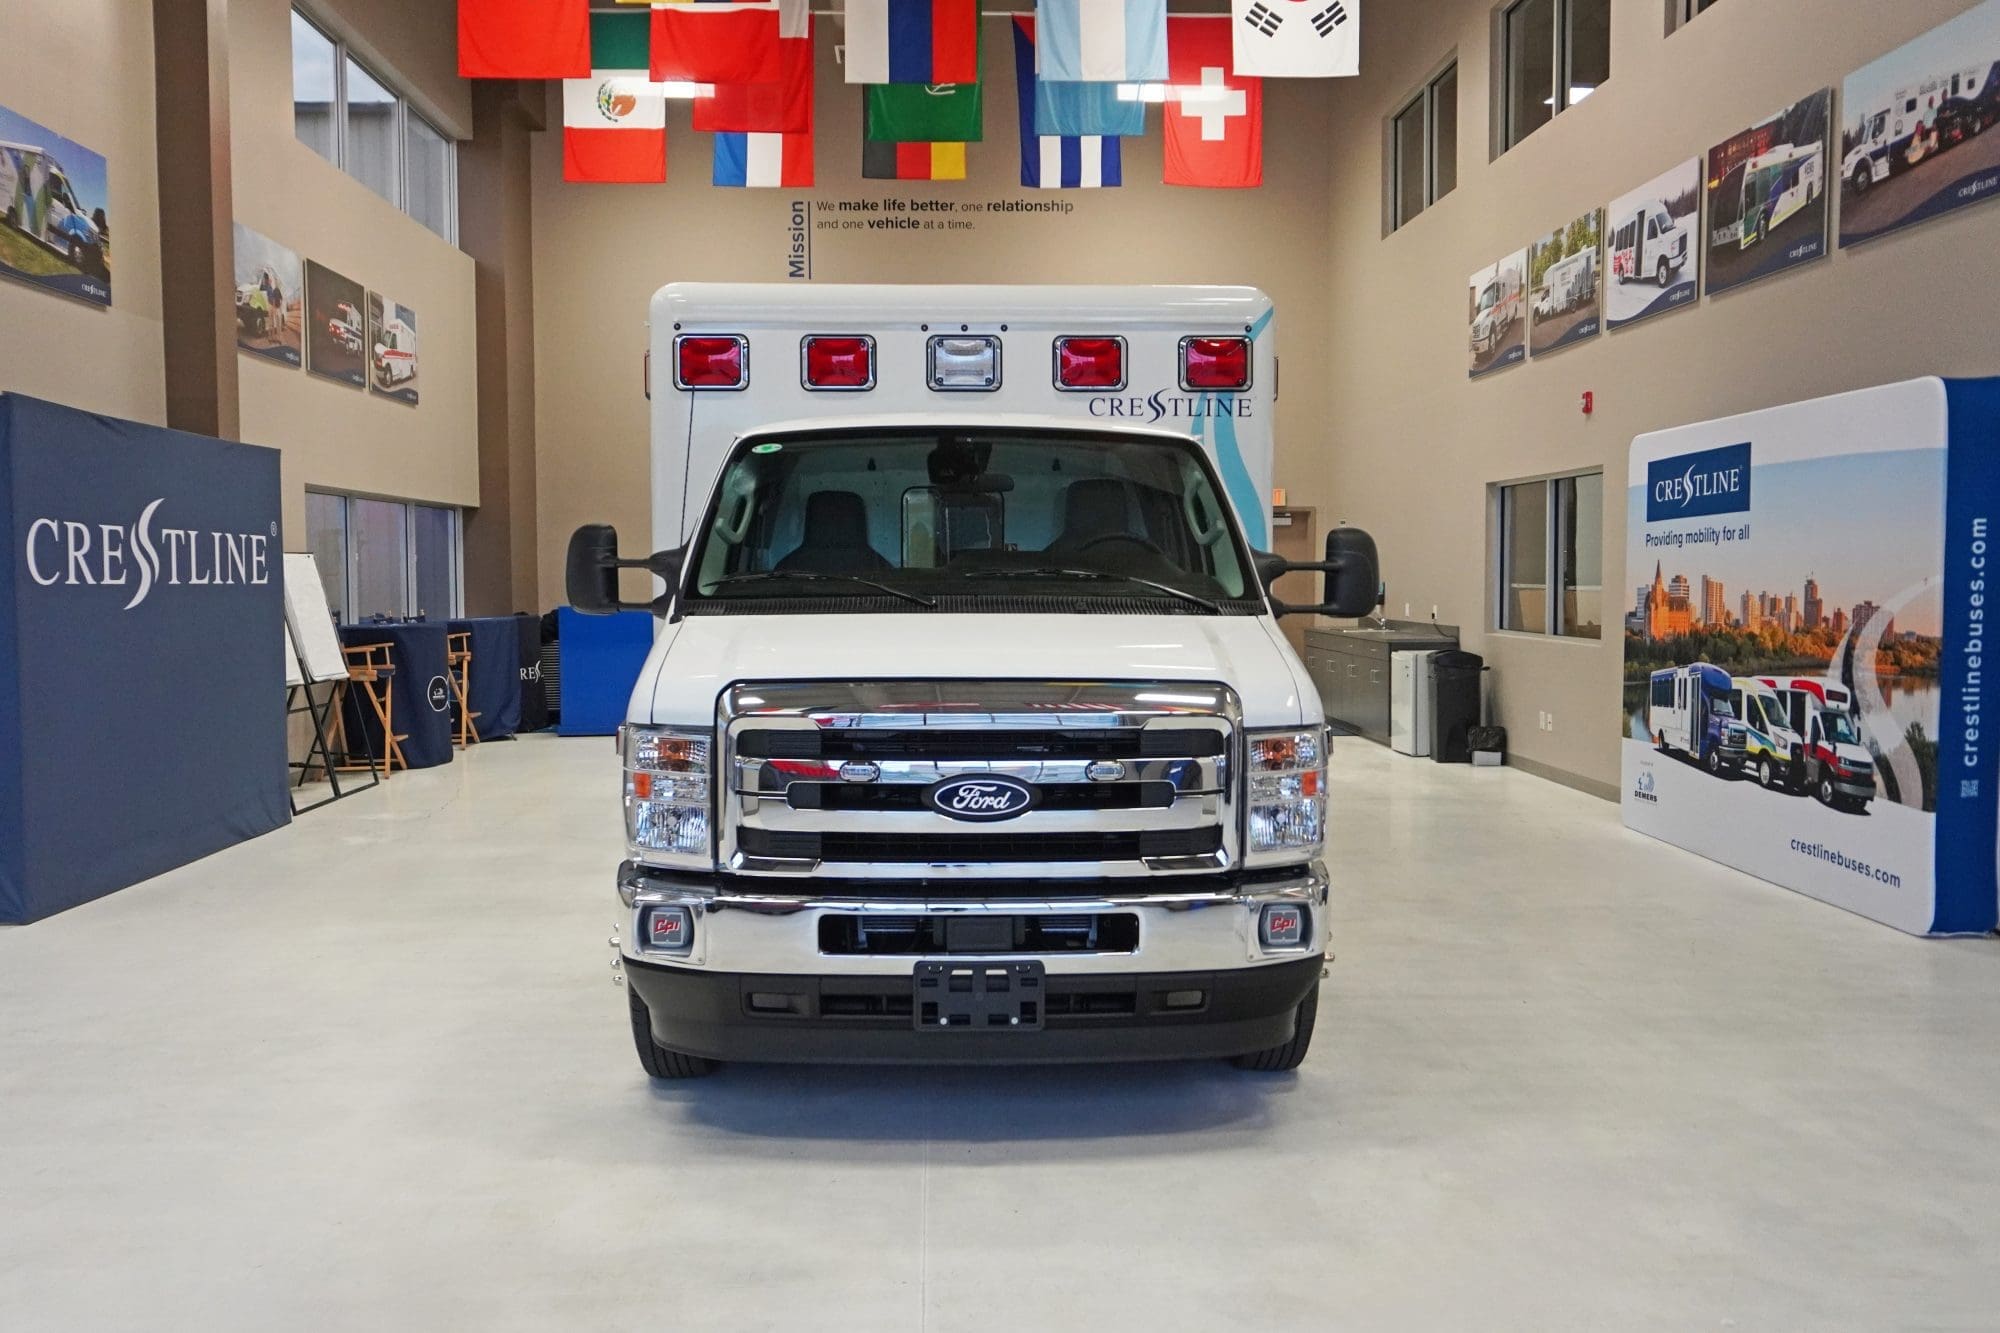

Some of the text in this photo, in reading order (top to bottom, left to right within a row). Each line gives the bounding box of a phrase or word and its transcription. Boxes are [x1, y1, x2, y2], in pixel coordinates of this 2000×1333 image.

[816, 199, 1074, 215] We make life better, one relationship
[816, 216, 976, 230] and one vehicle at a time.
[788, 200, 805, 279] Mission
[1088, 387, 1254, 424] CRESTLINE
[1655, 463, 1741, 508] CRESTLINE
[1645, 523, 1751, 549] Providing mobility for all
[1961, 517, 1988, 767] crestlinebuses.com
[519, 660, 544, 684] RES
[952, 783, 1011, 810] Ford
[1790, 838, 1901, 889] crestlinebuses.com
